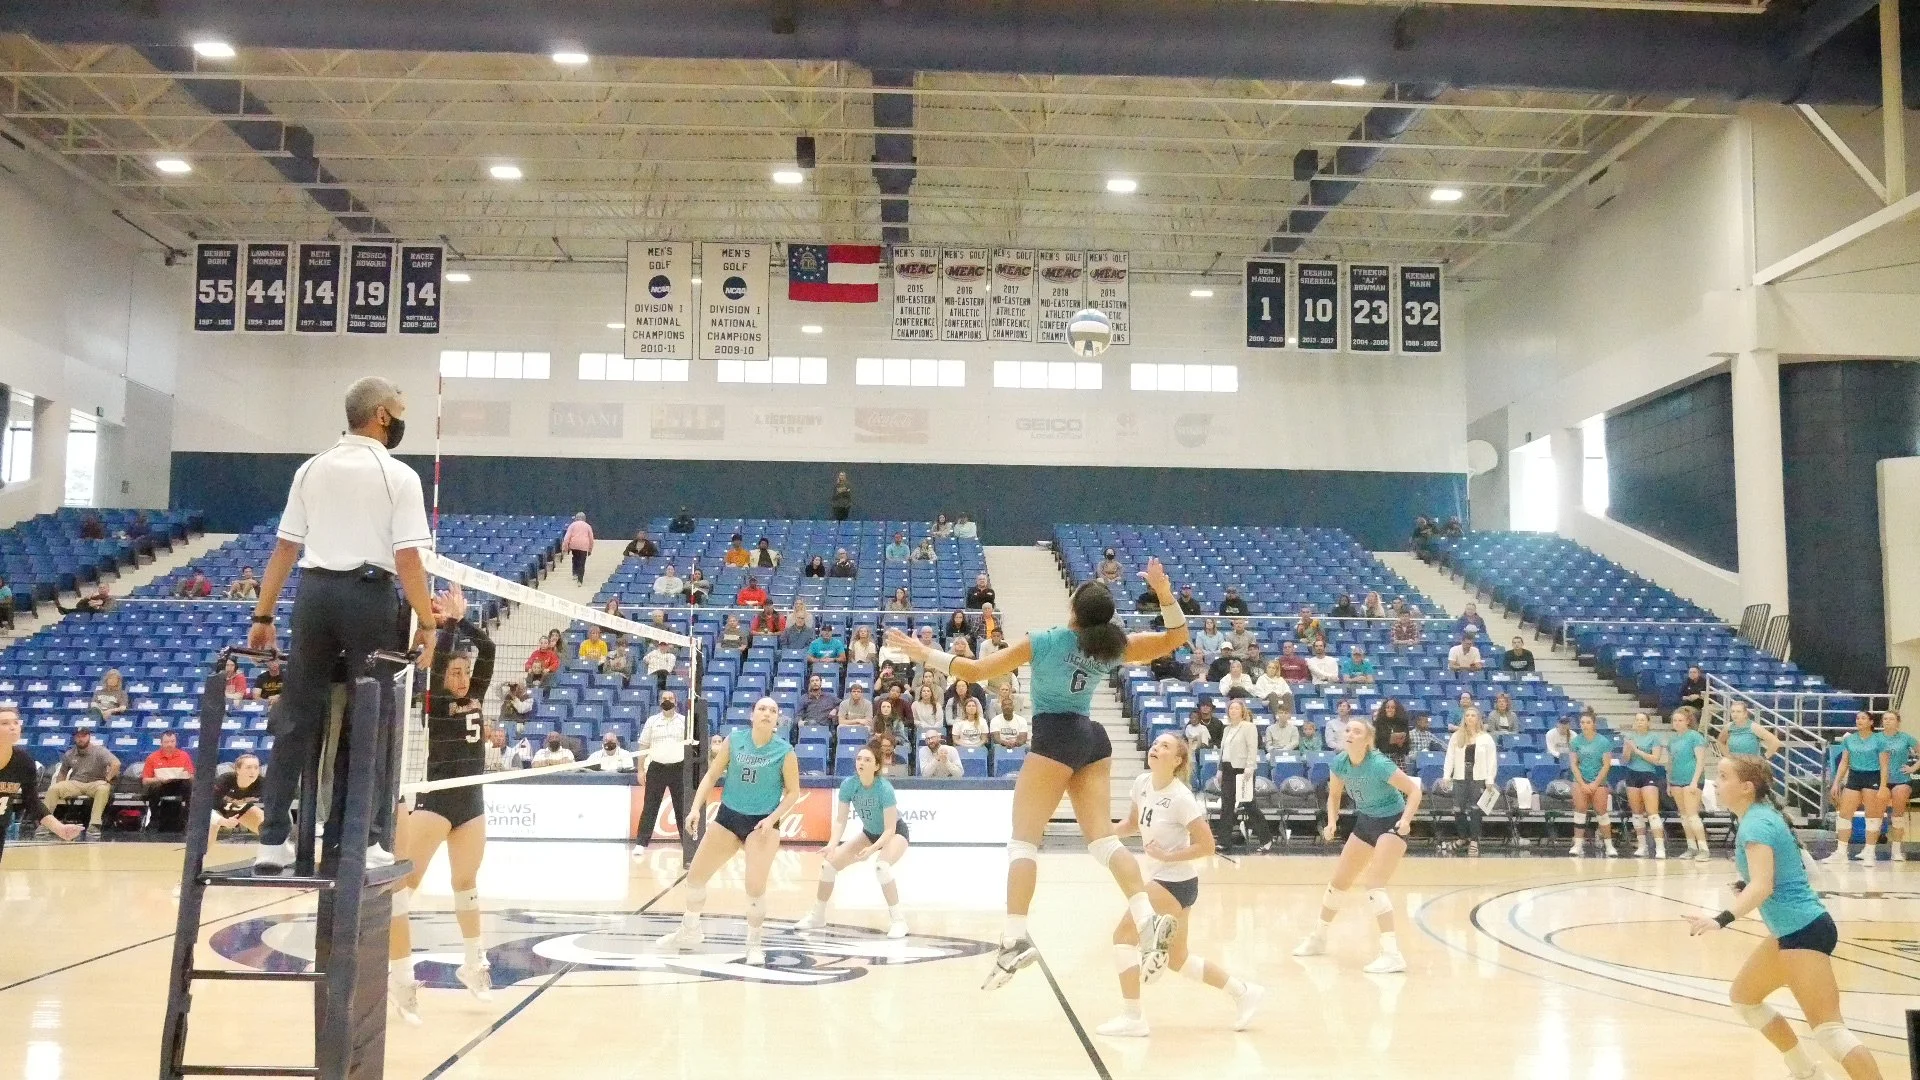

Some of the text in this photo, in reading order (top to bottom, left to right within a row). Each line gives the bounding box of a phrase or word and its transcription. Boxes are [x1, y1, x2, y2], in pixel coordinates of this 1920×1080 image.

[648, 247, 673, 256] MEN'S
[722, 248, 751, 258] MEN'S
[894, 249, 937, 258] MEN'S GOLF
[944, 250, 986, 260] MEN'S GOLF
[994, 248, 1032, 260] MEN'S GOLF
[1040, 252, 1082, 262] MEN'S GOLF
[1090, 253, 1108, 262] MEN'S
[356, 260, 387, 268] HOWARD
[649, 260, 672, 270] GOLF
[723, 262, 749, 272] GOLF
[1251, 276, 1281, 284] MADGEN
[198, 279, 234, 304] 55
[246, 279, 286, 304] 44
[303, 280, 334, 304] 14
[355, 280, 385, 306] 19
[650, 286, 671, 294] NCAA
[907, 284, 924, 293] 2015
[956, 286, 973, 295] 2016
[1004, 284, 1020, 294] 2017
[1052, 288, 1069, 297] 2018
[406, 282, 437, 306] 14
[896, 295, 936, 304] MID-EASTERN
[944, 296, 984, 306] MID-EASTERN
[992, 296, 1031, 306] MID-EASTERN
[1040, 298, 1081, 308] MID-EASTERN
[634, 304, 674, 313] DIVISION
[709, 304, 750, 314] DIVISION
[1088, 300, 1127, 310] MID-EASTERN
[1260, 296, 1272, 321] 1
[1304, 298, 1333, 322] 10
[900, 306, 931, 315] ATHLETIC
[949, 308, 980, 317] ATHLETIC
[996, 306, 1026, 316] ATHLETIC
[1354, 300, 1388, 324] 23
[1404, 301, 1439, 326] 32
[636, 317, 681, 326] NATIONAL
[711, 318, 758, 328] NATIONAL
[895, 318, 935, 326] CONFERENCE
[944, 318, 984, 328] CONFERENCE
[992, 318, 1030, 328] CONFERENCE
[632, 330, 685, 340] CHAMPIONS
[707, 332, 762, 342] CHAMPIONS
[897, 328, 934, 338] CHAMPIONS
[946, 330, 982, 339] CHAMPIONS
[992, 330, 1028, 339] CHAMPIONS
[1042, 331, 1066, 340] CHAMPI
[640, 344, 676, 353] 2010-11
[714, 345, 755, 355] 2009-10
[1016, 418, 1082, 432] GEICO
[466, 712, 480, 743] 5
[741, 767, 757, 784] 21
[485, 801, 532, 814] News
[488, 812, 536, 826] annel
[900, 810, 937, 820] MARY
[1140, 806, 1154, 828] 14
